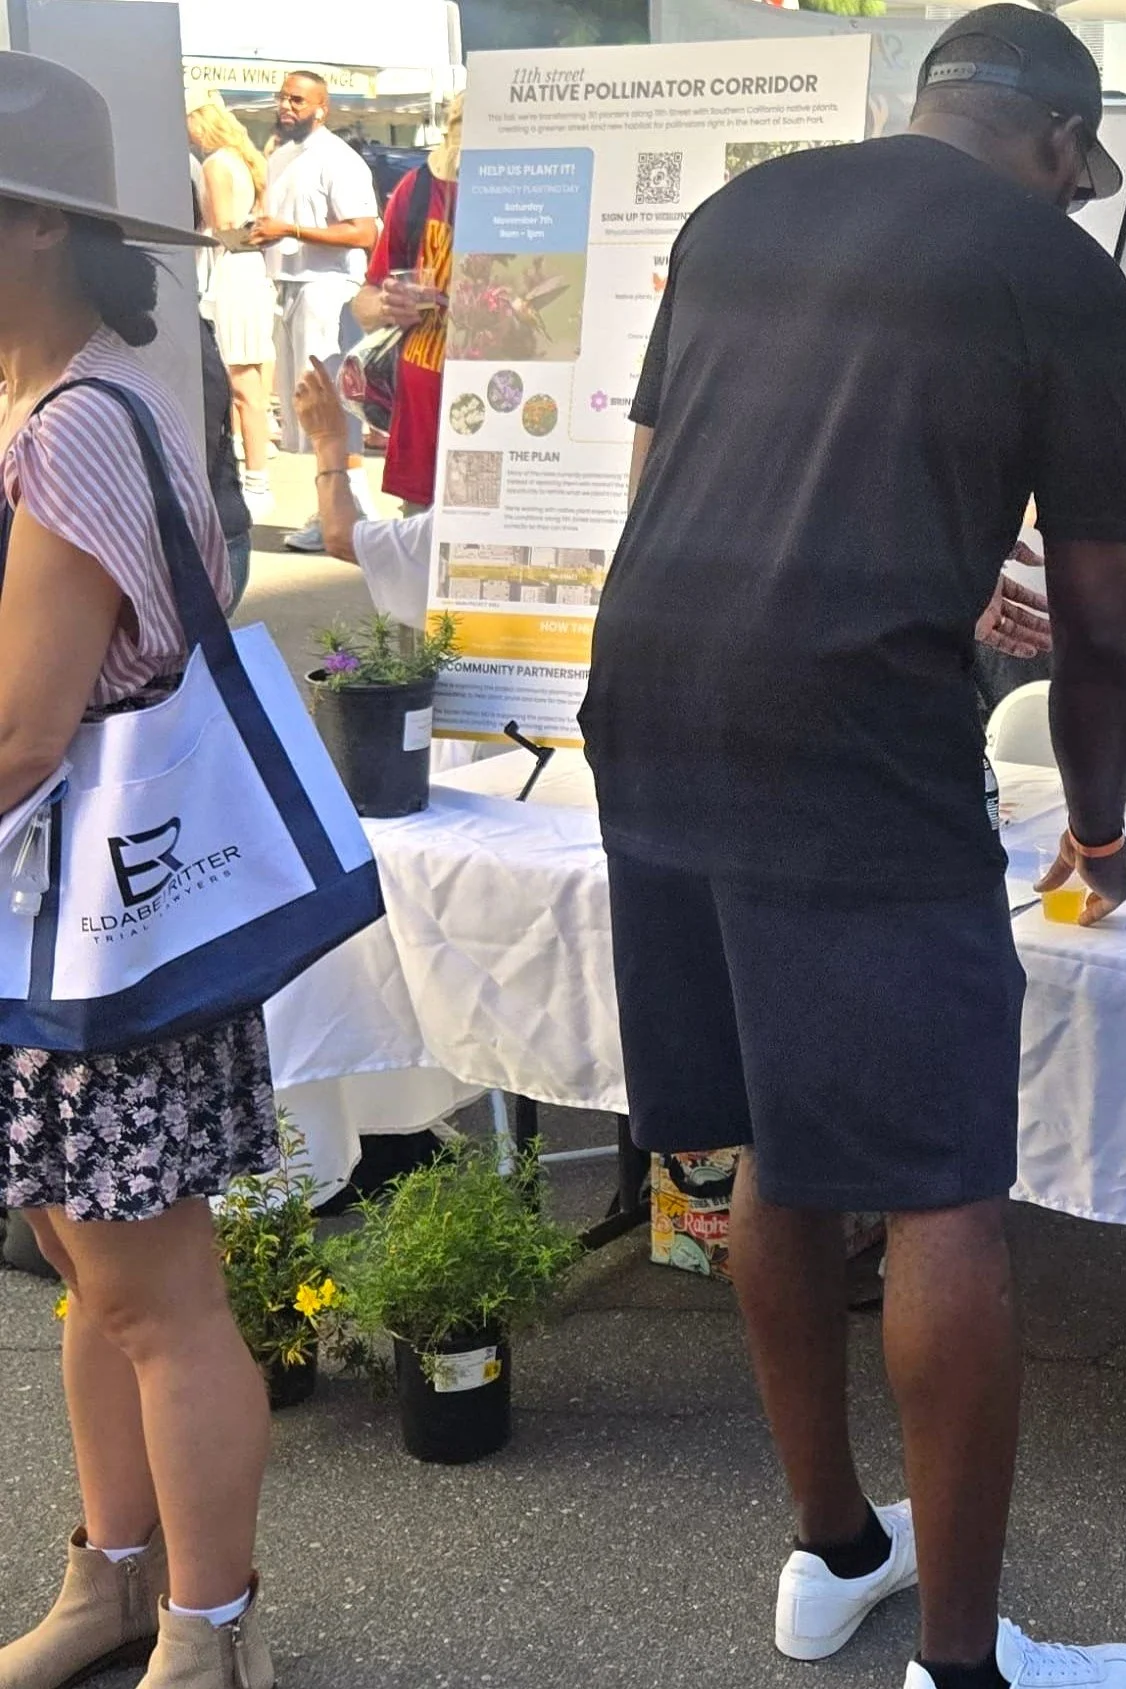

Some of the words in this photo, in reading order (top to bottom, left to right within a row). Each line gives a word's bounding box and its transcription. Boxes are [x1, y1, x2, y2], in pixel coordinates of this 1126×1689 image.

[184, 65, 237, 83] ORNIA
[243, 68, 277, 84] WINE
[512, 67, 541, 84] 11th
[545, 68, 585, 83] street
[510, 83, 580, 103] NATIVE
[584, 79, 706, 100] POLLINATOR
[710, 74, 818, 96] CORRIDOR
[747, 105, 784, 114] California
[479, 164, 505, 176] HELP
[507, 164, 521, 176] US
[523, 164, 558, 176] PLANT
[601, 213, 624, 222] SIGN
[626, 213, 638, 221] UP
[639, 212, 653, 221] TO
[508, 450, 530, 462] THE
[531, 451, 560, 462] PLAN
[540, 621, 568, 634] HOW
[446, 661, 515, 676] COMMUNITY
[94, 925, 149, 945] TRIAL
